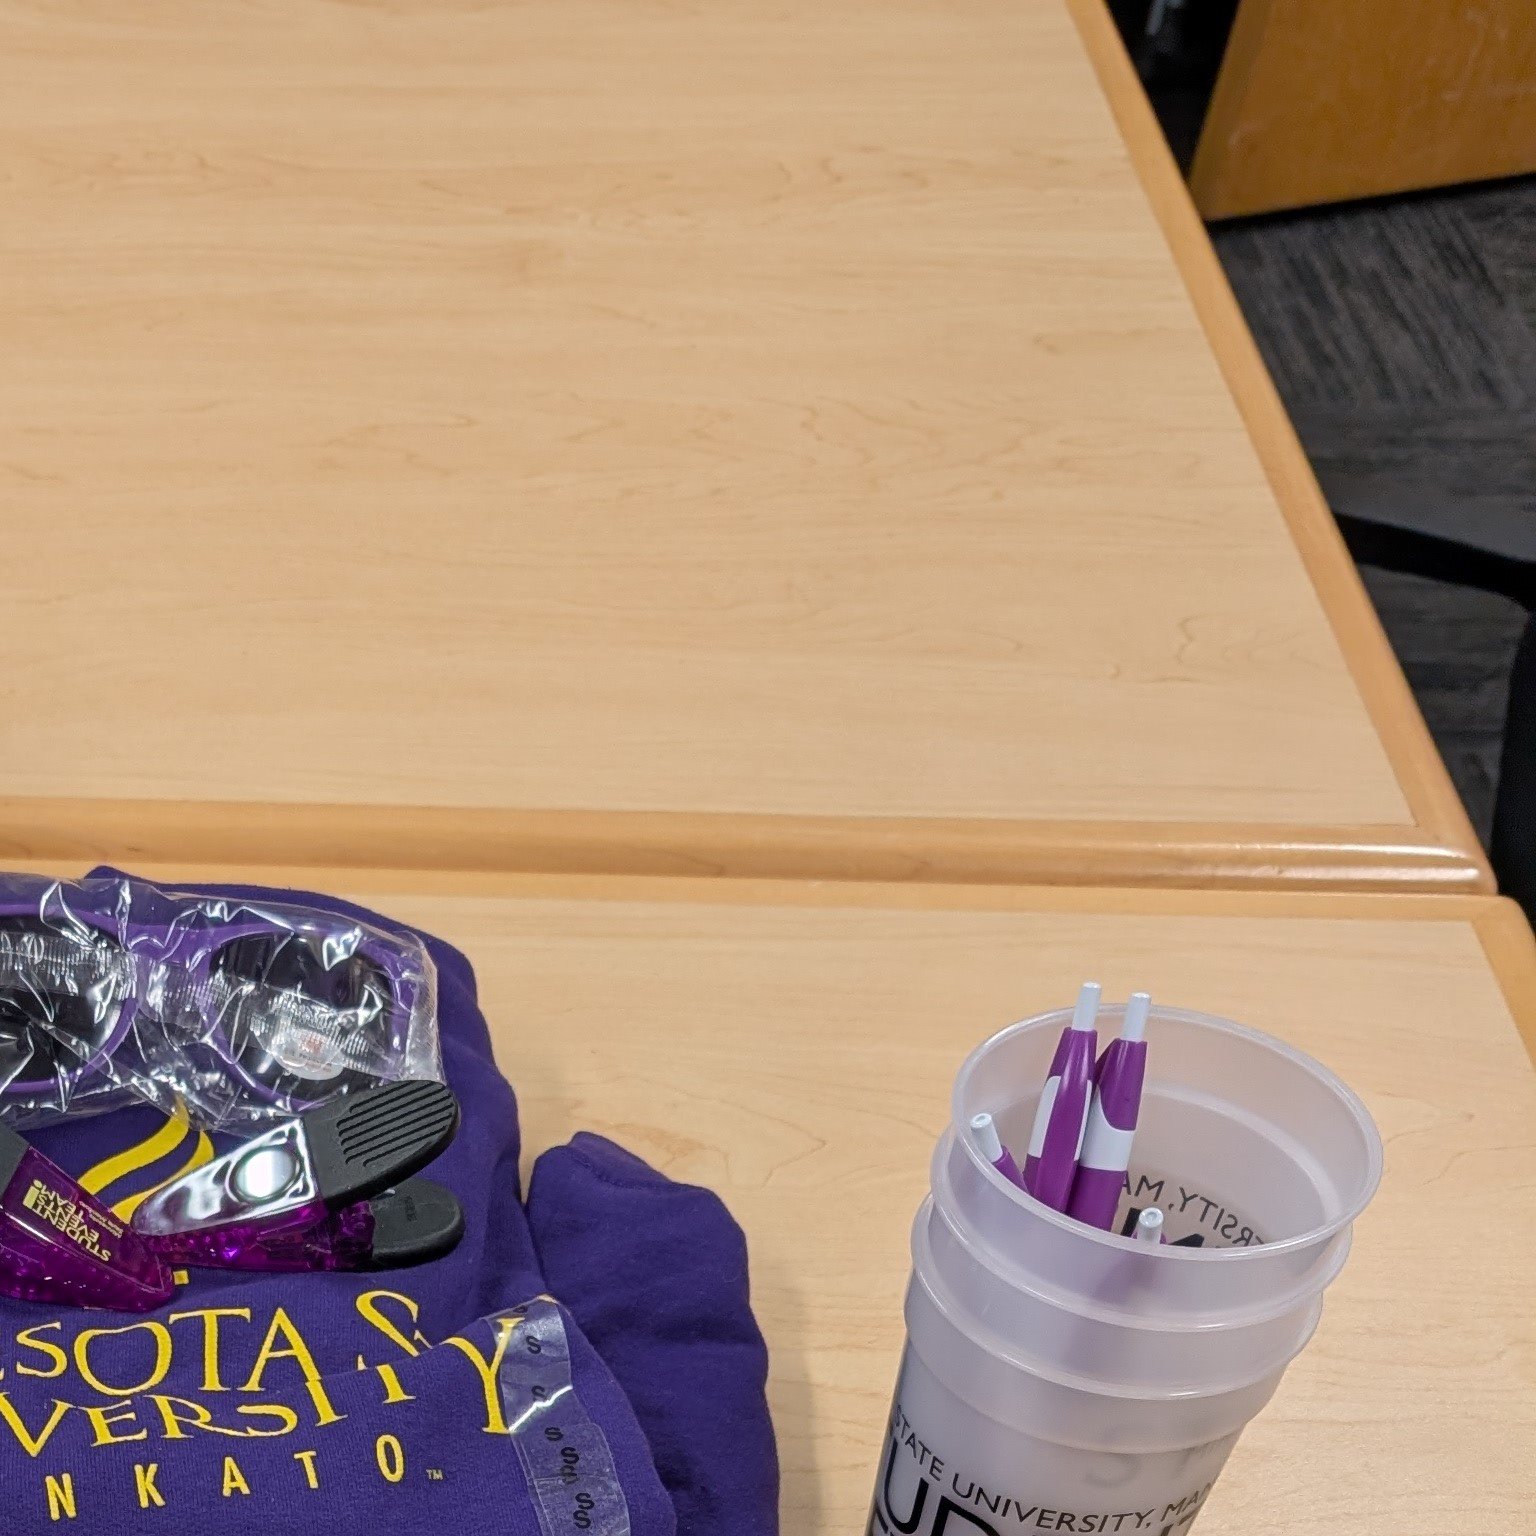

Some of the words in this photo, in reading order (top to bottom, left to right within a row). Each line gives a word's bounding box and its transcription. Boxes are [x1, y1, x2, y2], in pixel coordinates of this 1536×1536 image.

[31, 1204, 112, 1262] STUDENT
[37, 1194, 99, 1242] EVENTS
[952, 1473, 1156, 1533] UNIVERSITY,
